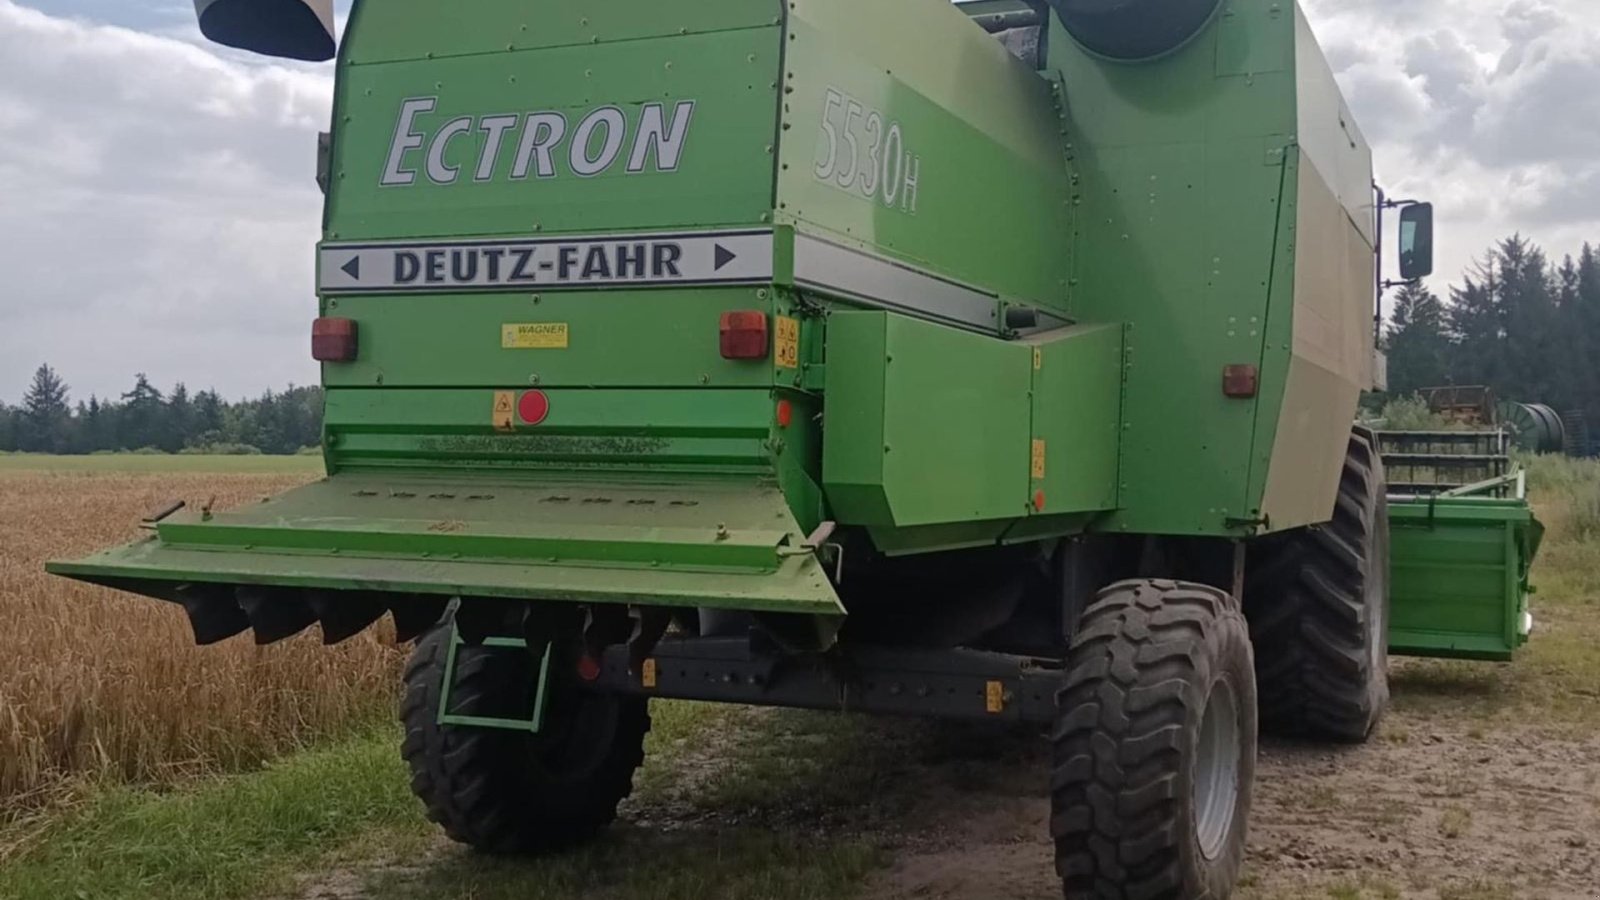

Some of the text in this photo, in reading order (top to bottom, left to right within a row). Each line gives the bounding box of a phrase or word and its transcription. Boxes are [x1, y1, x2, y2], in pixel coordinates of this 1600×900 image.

[380, 96, 695, 187] ECTRON
[813, 86, 919, 215] 5530H
[393, 242, 683, 284] DEUTZ-FAHR
[518, 325, 565, 334] WAGNER
